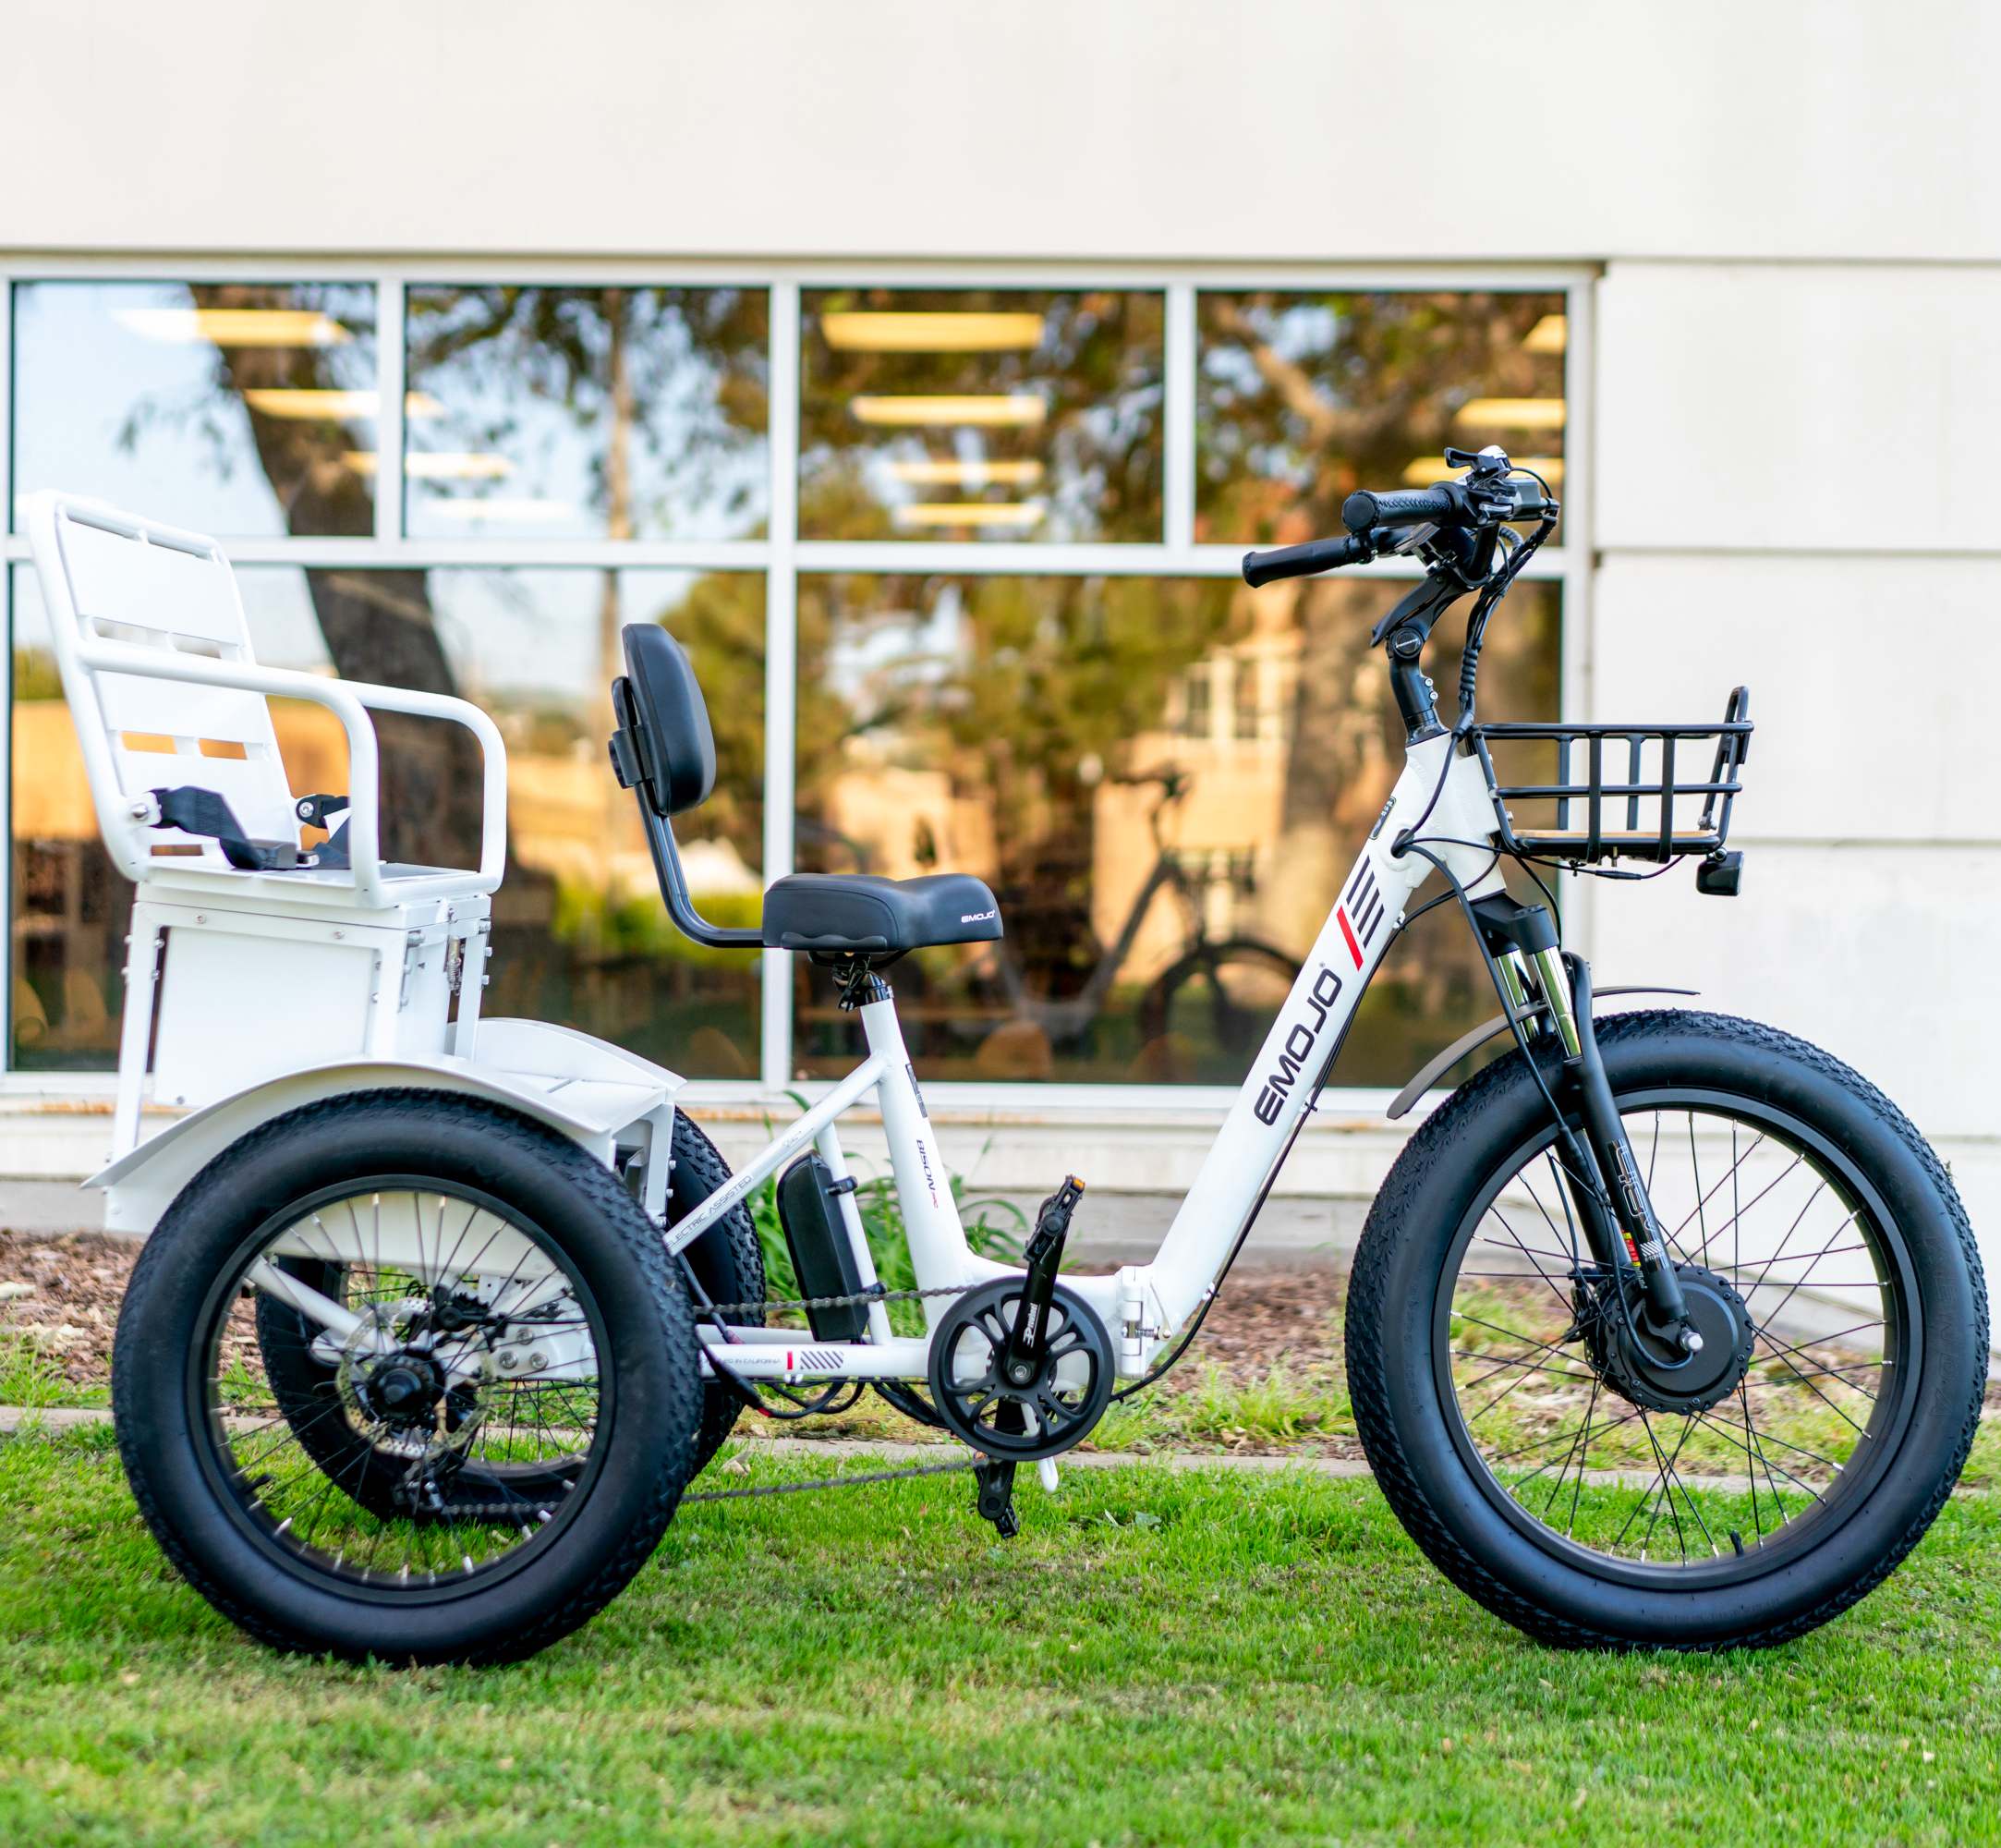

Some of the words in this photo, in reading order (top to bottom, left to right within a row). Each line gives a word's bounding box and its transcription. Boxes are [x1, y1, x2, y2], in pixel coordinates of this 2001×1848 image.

[961, 911, 994, 923] EMOJO
[1254, 968, 1343, 1126] EMOJO
[916, 1138, 936, 1190] BISON
[709, 1175, 754, 1216] ASSISTED
